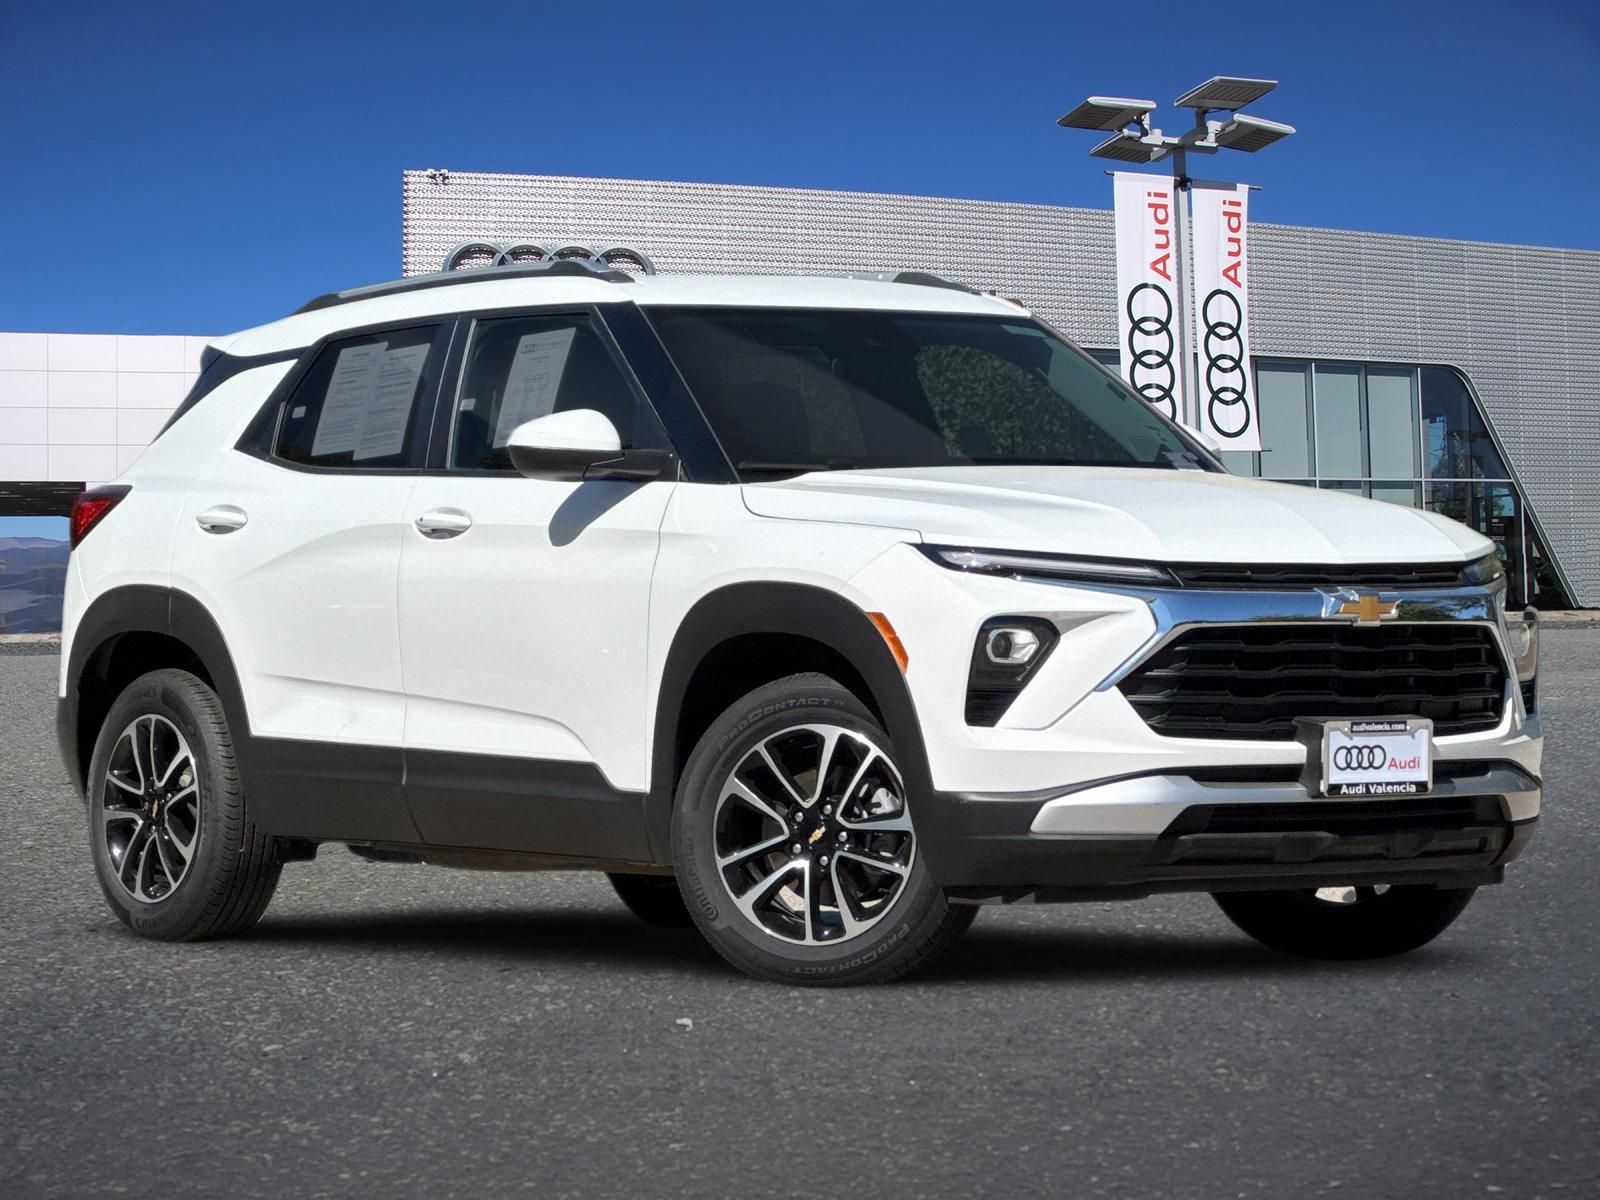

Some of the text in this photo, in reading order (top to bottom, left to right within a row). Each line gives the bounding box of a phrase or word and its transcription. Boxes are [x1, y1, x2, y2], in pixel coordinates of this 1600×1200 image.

[1147, 191, 1171, 282] Audi
[1222, 199, 1242, 289] Audi
[1340, 782, 1416, 794] Audi Valencia
[1387, 757, 1421, 769] Audi
